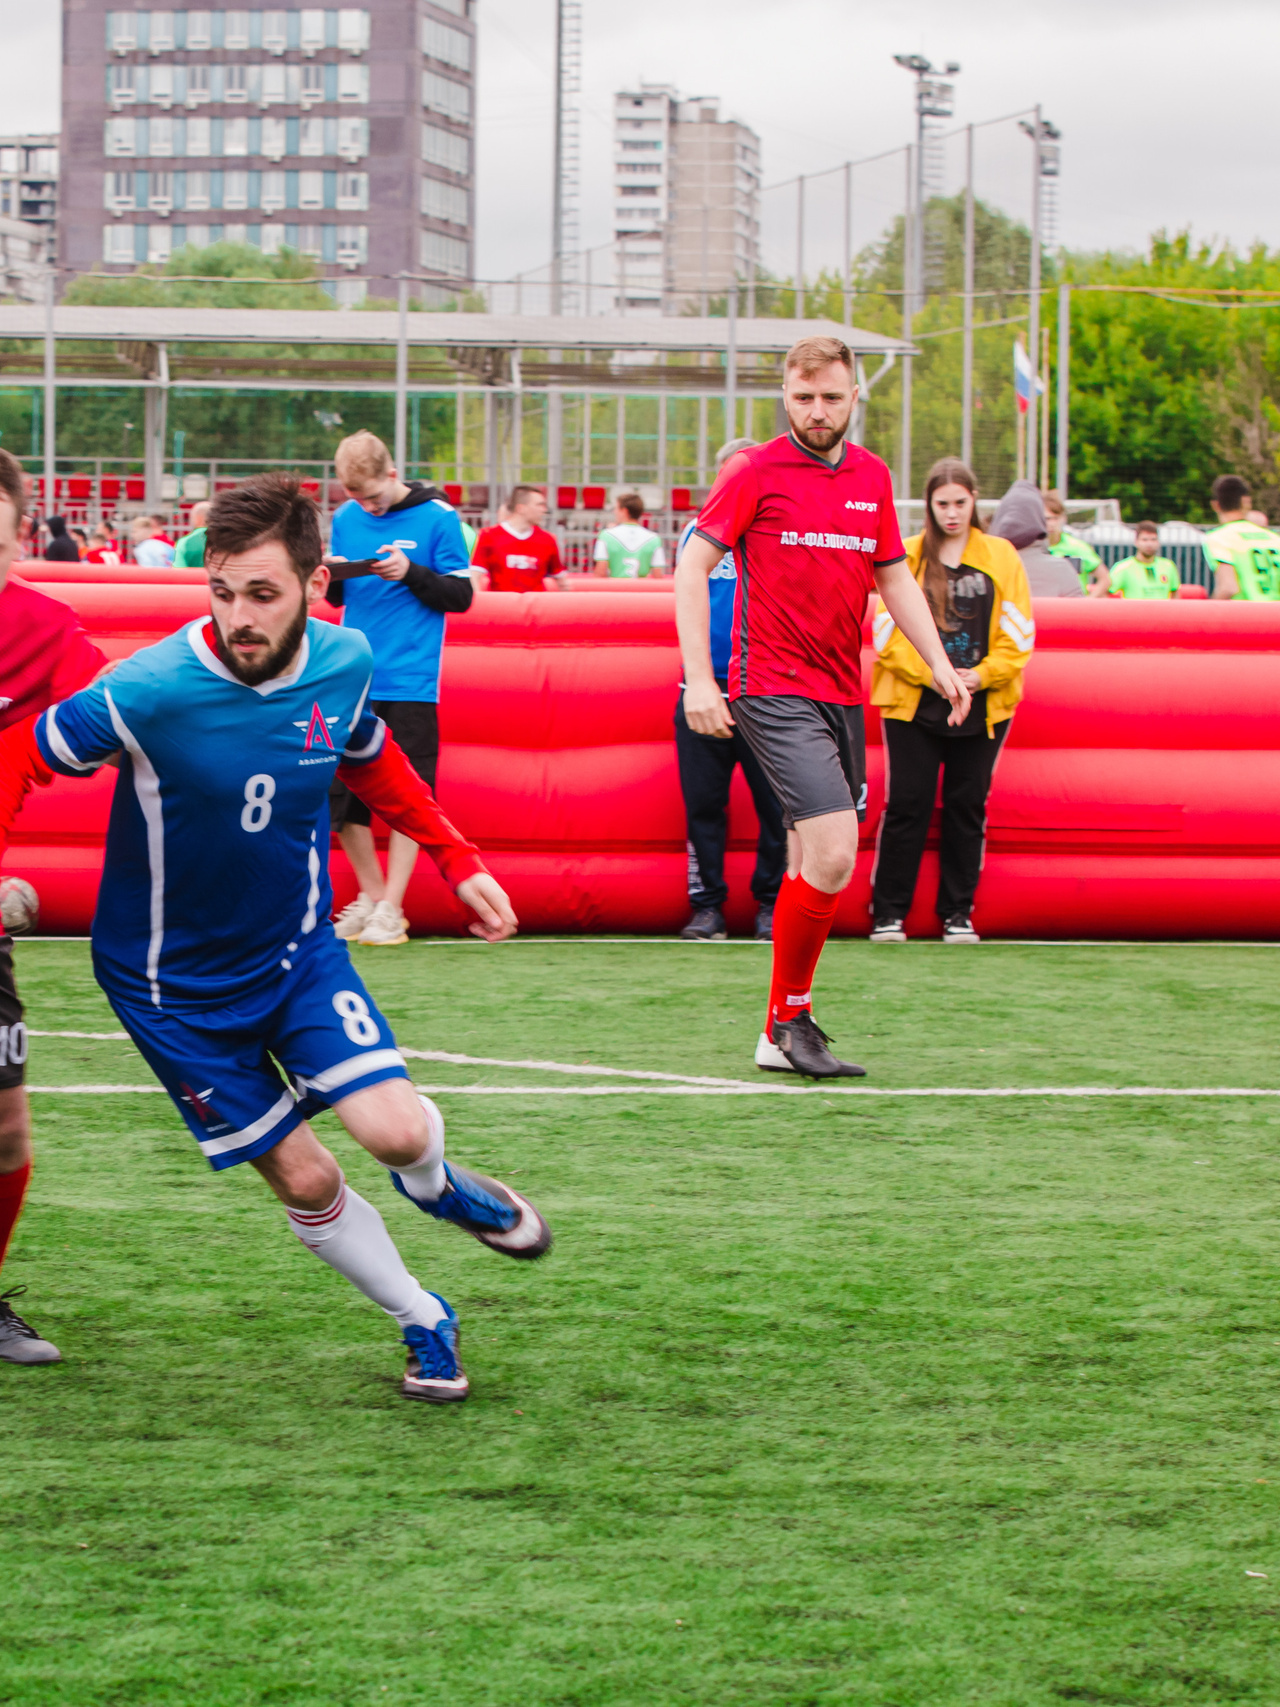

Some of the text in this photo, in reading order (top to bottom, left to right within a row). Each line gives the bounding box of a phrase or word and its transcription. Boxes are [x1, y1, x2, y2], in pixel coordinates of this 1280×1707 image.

[854, 501, 878, 513] КРЭТ
[240, 773, 277, 833] 8
[856, 783, 868, 810] 2
[331, 990, 381, 1046] 8
